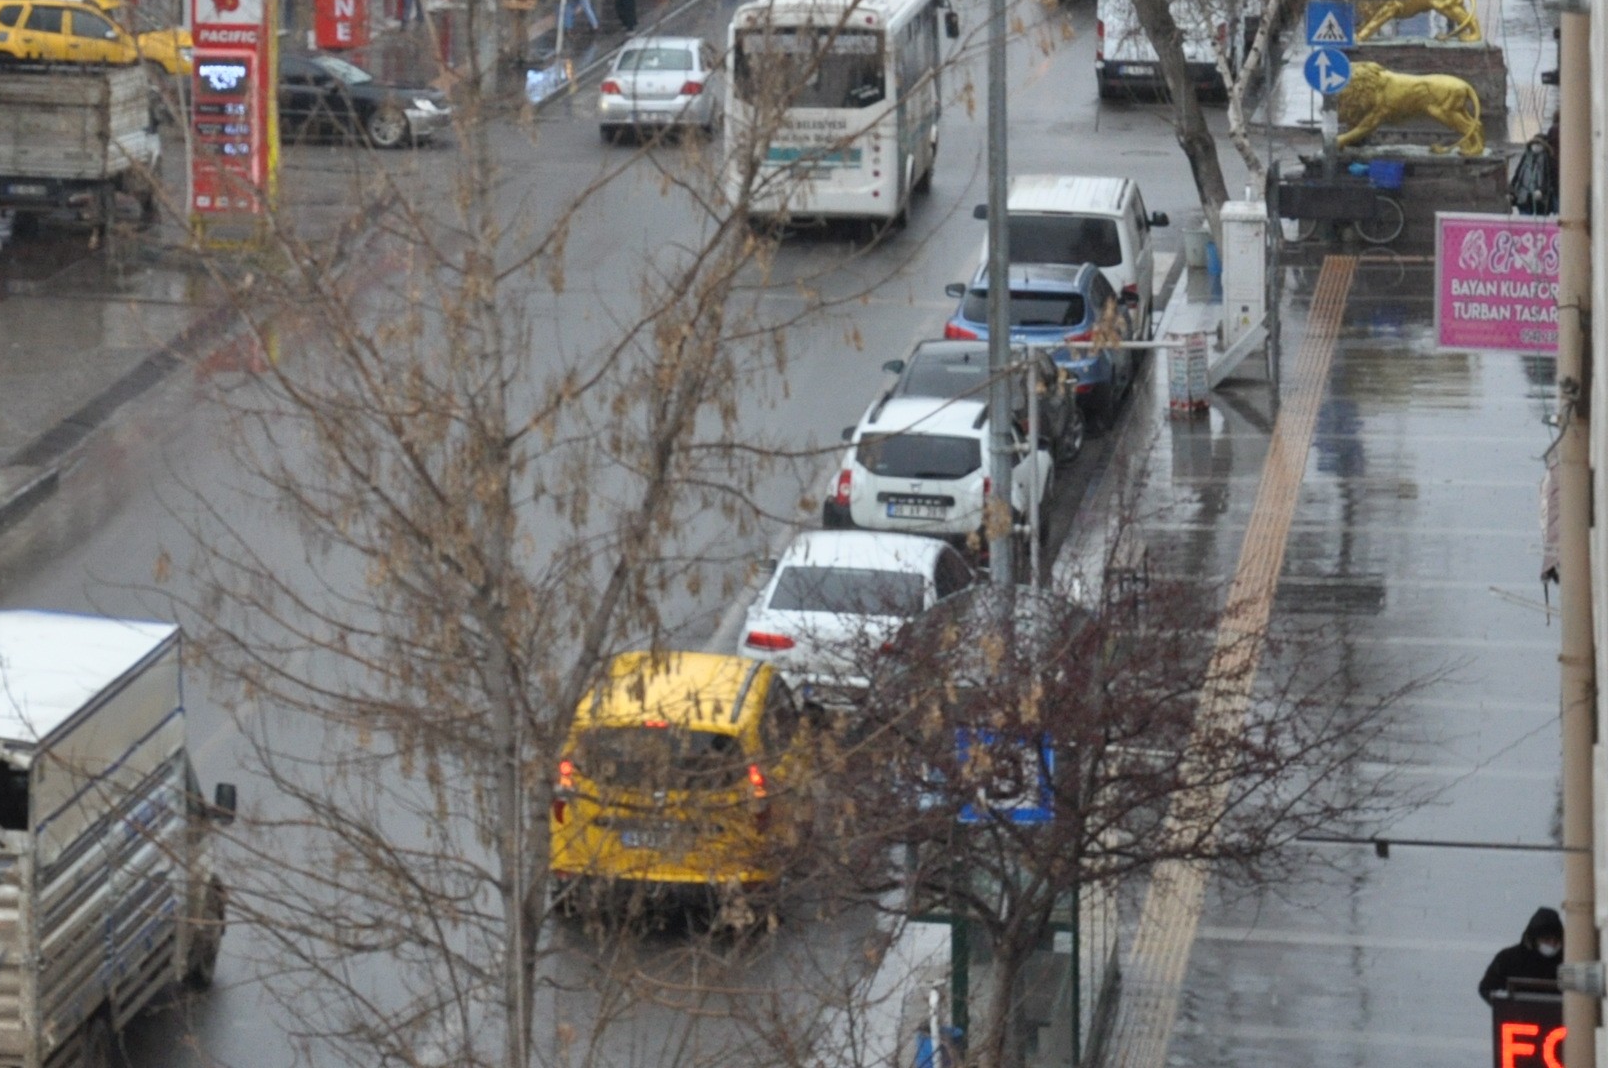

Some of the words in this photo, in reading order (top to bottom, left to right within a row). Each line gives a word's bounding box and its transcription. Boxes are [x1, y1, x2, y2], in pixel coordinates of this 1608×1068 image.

[199, 28, 258, 43] PACIFIC
[1452, 278, 1497, 297] BAYAN
[1452, 301, 1511, 321] TURBAN
